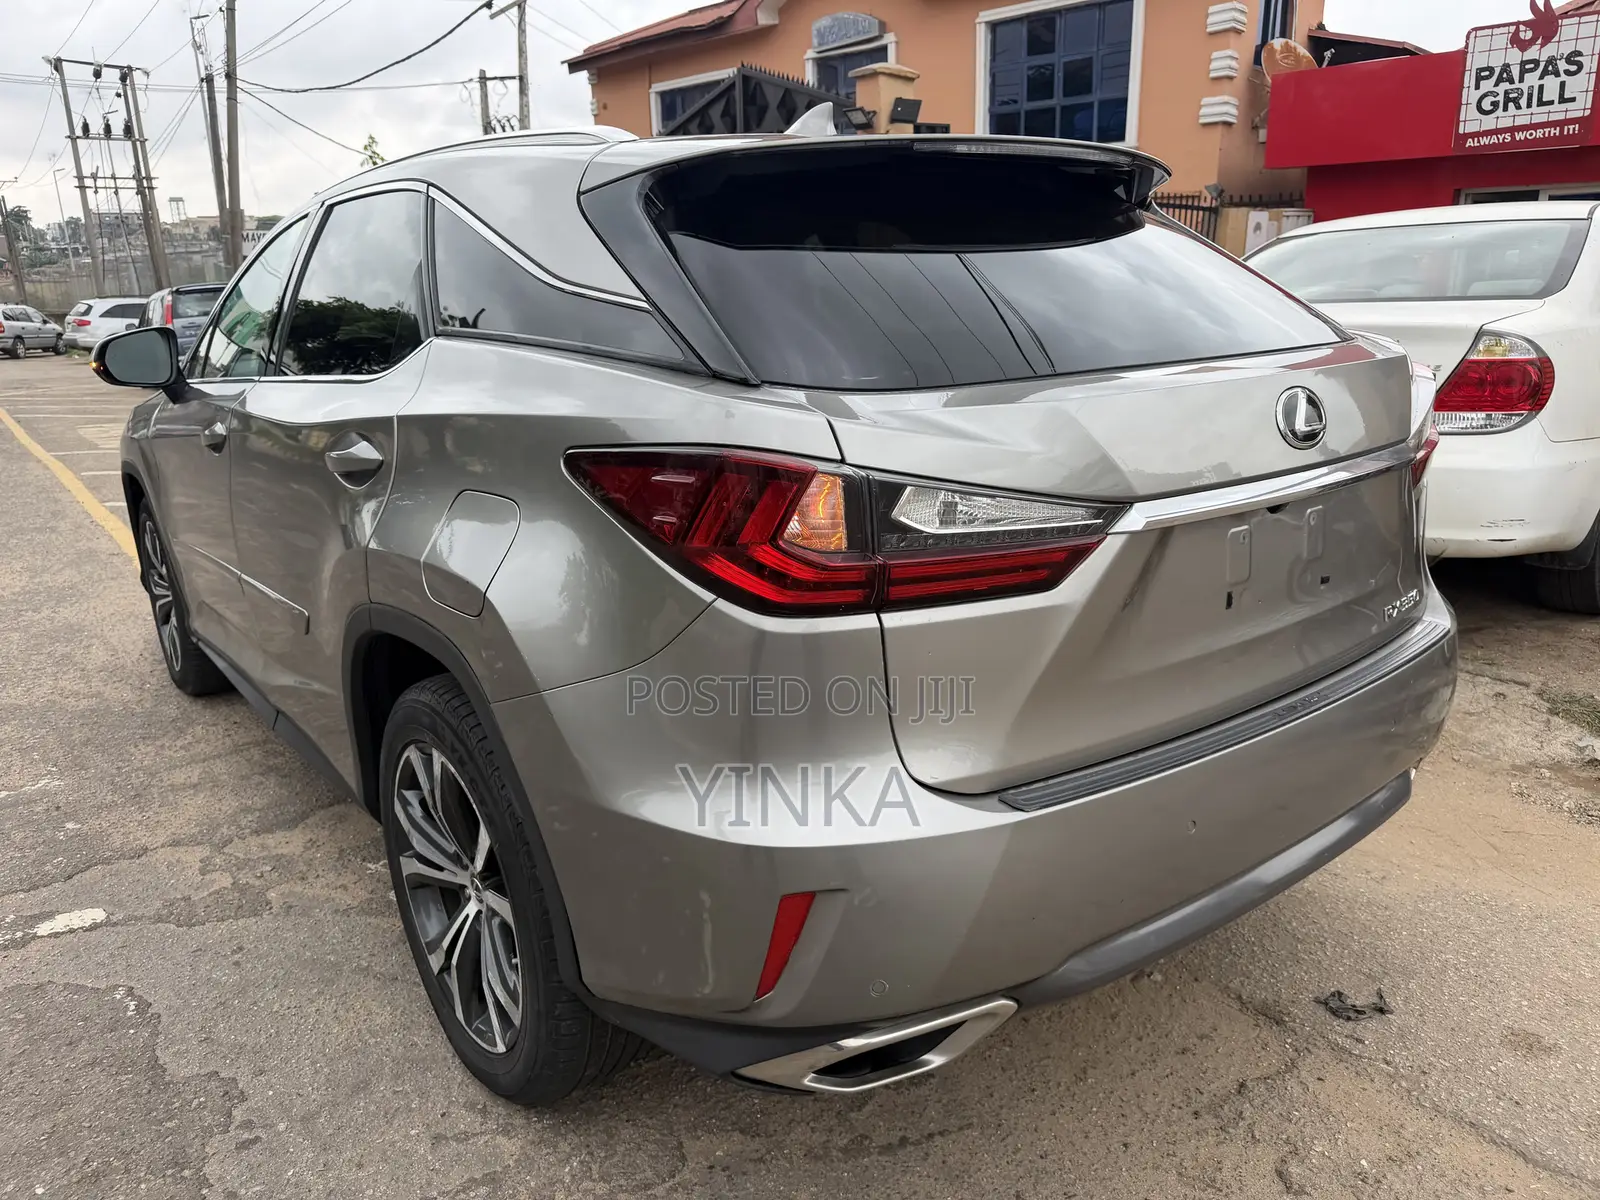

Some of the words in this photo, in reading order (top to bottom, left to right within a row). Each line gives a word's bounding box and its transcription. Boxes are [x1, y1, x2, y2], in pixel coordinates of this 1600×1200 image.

[1474, 50, 1584, 90] PAPA'S
[1476, 80, 1577, 116] GRILL
[1465, 133, 1512, 148] ALWAYS
[1515, 127, 1560, 141] WORTH
[1563, 124, 1579, 135] IT!
